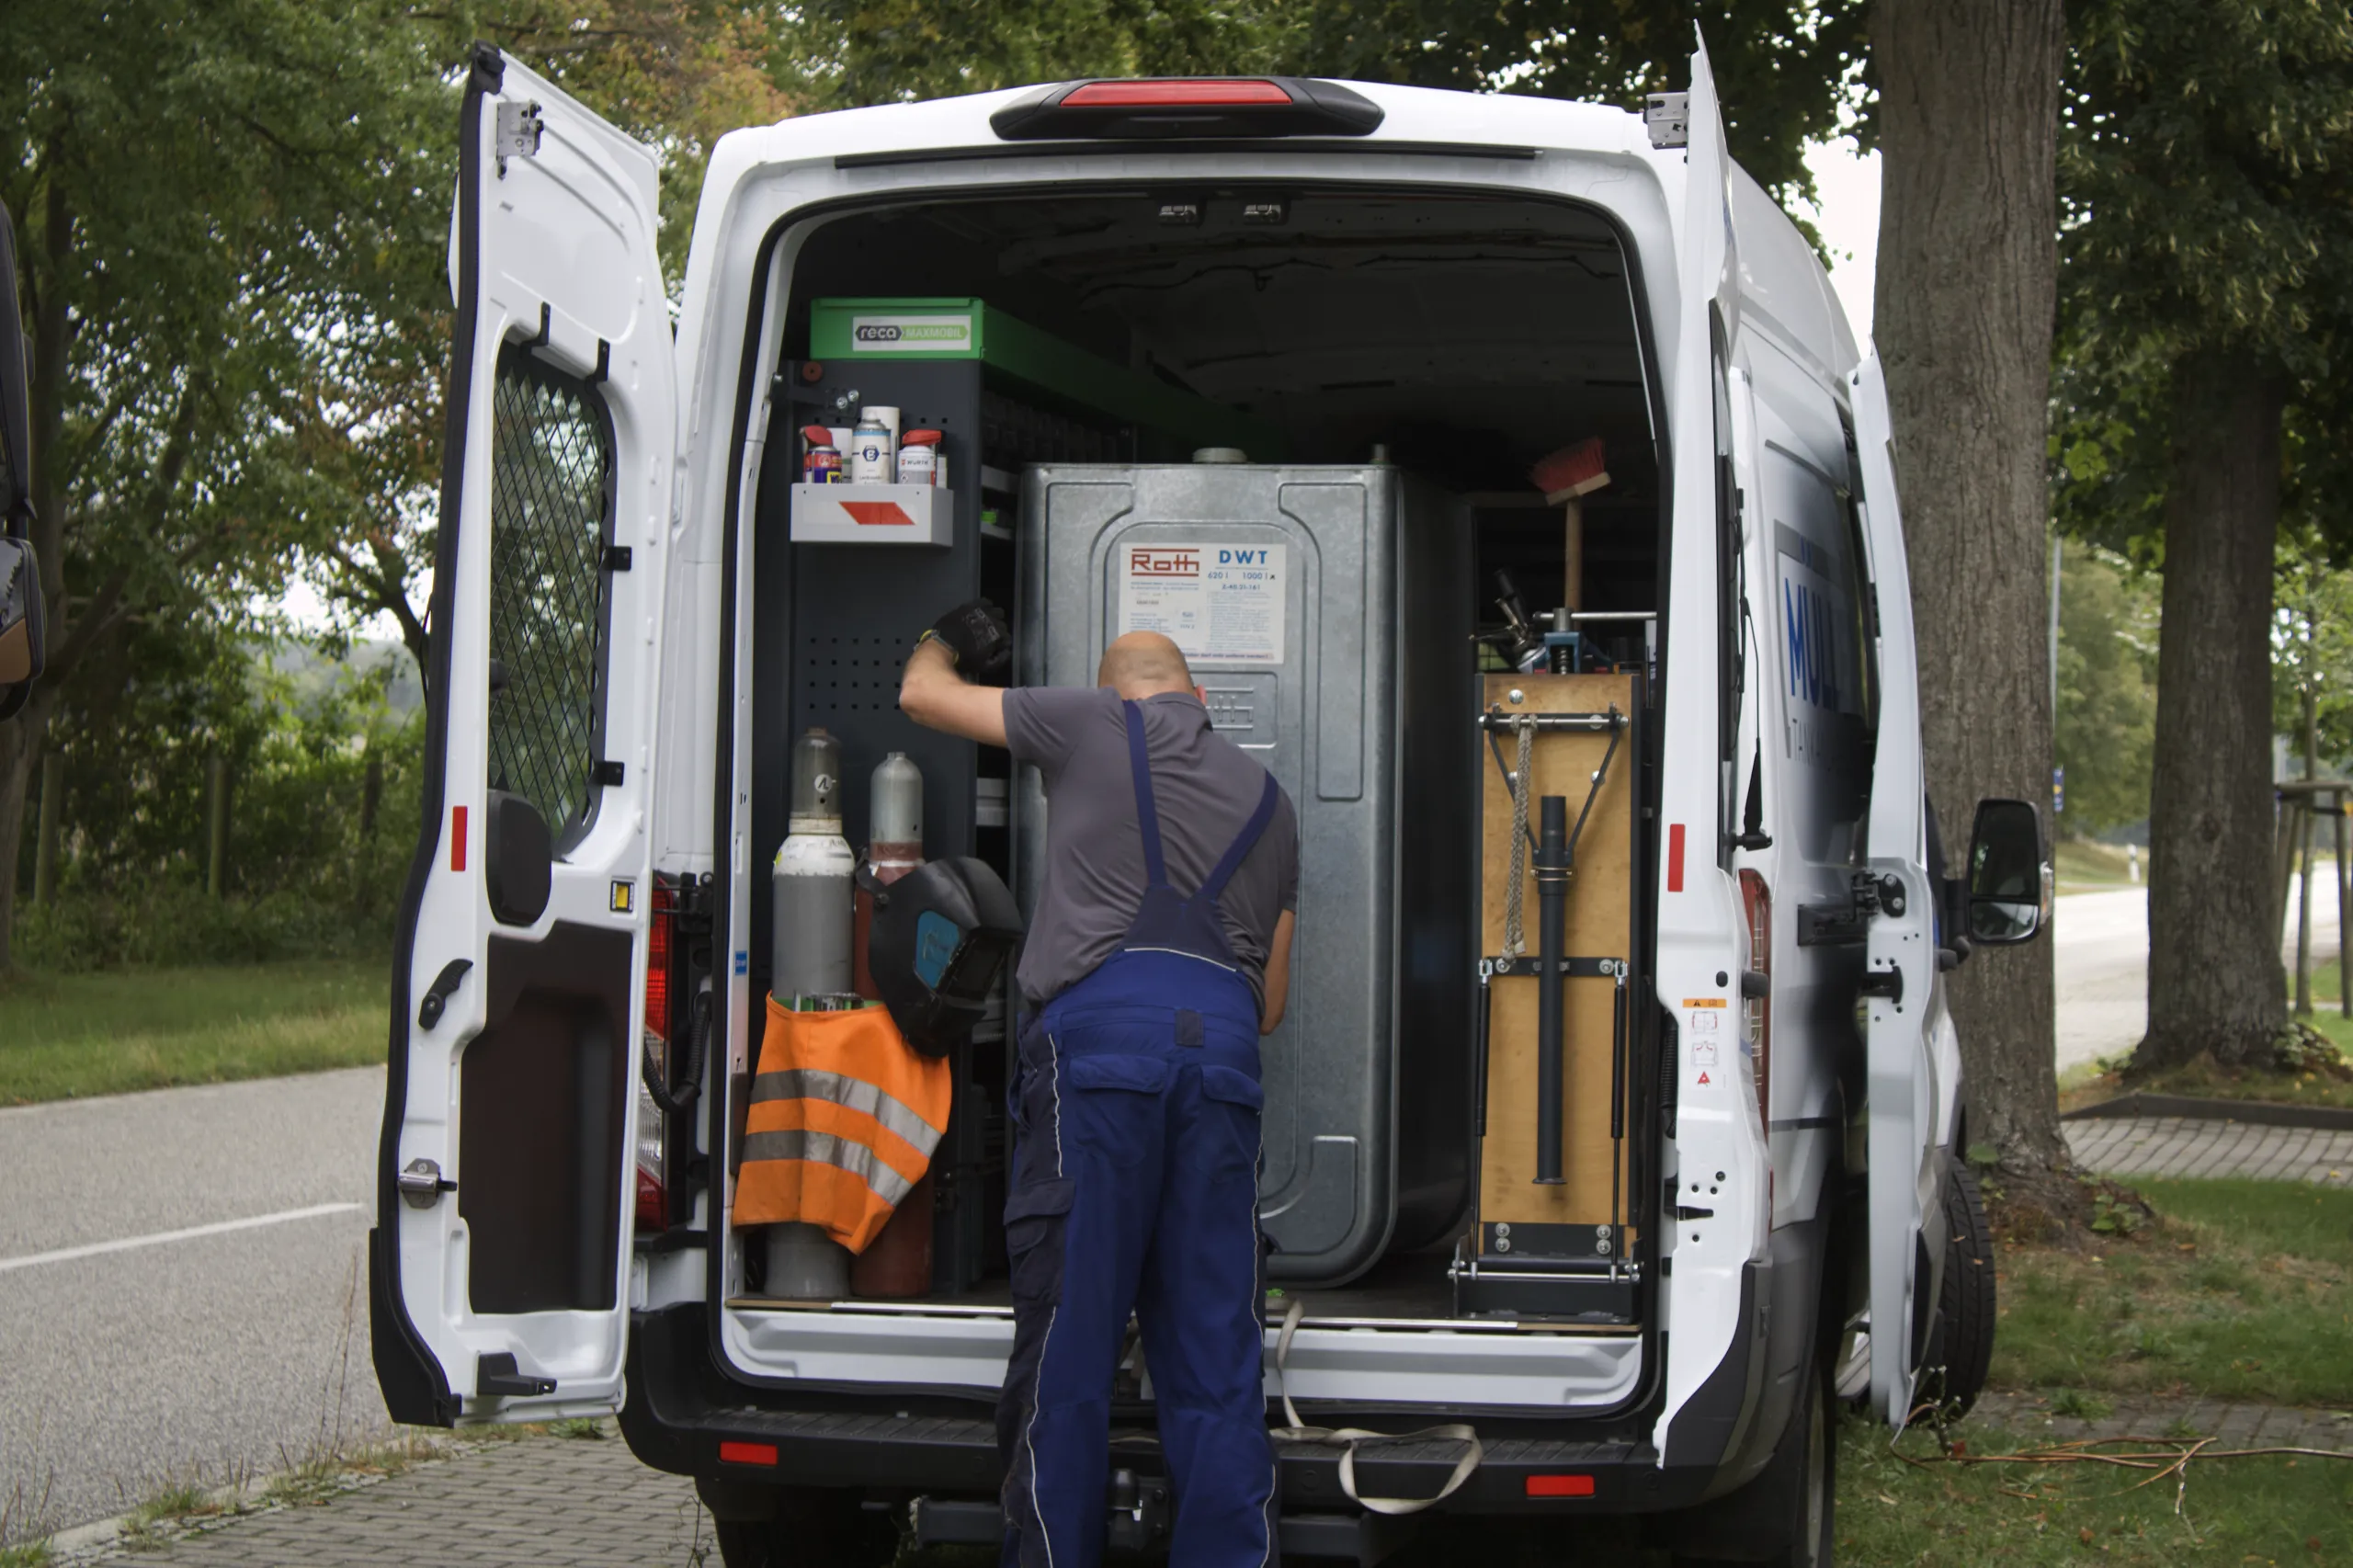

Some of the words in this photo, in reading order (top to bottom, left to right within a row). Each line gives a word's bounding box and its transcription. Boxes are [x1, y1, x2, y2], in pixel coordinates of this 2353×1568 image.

[860, 326, 897, 339] reca
[905, 326, 962, 338] MAXMOBIL
[1131, 553, 1199, 572] Roth
[1219, 550, 1268, 564] DWT
[1207, 571, 1223, 580] 620
[1243, 572, 1263, 580] 1000
